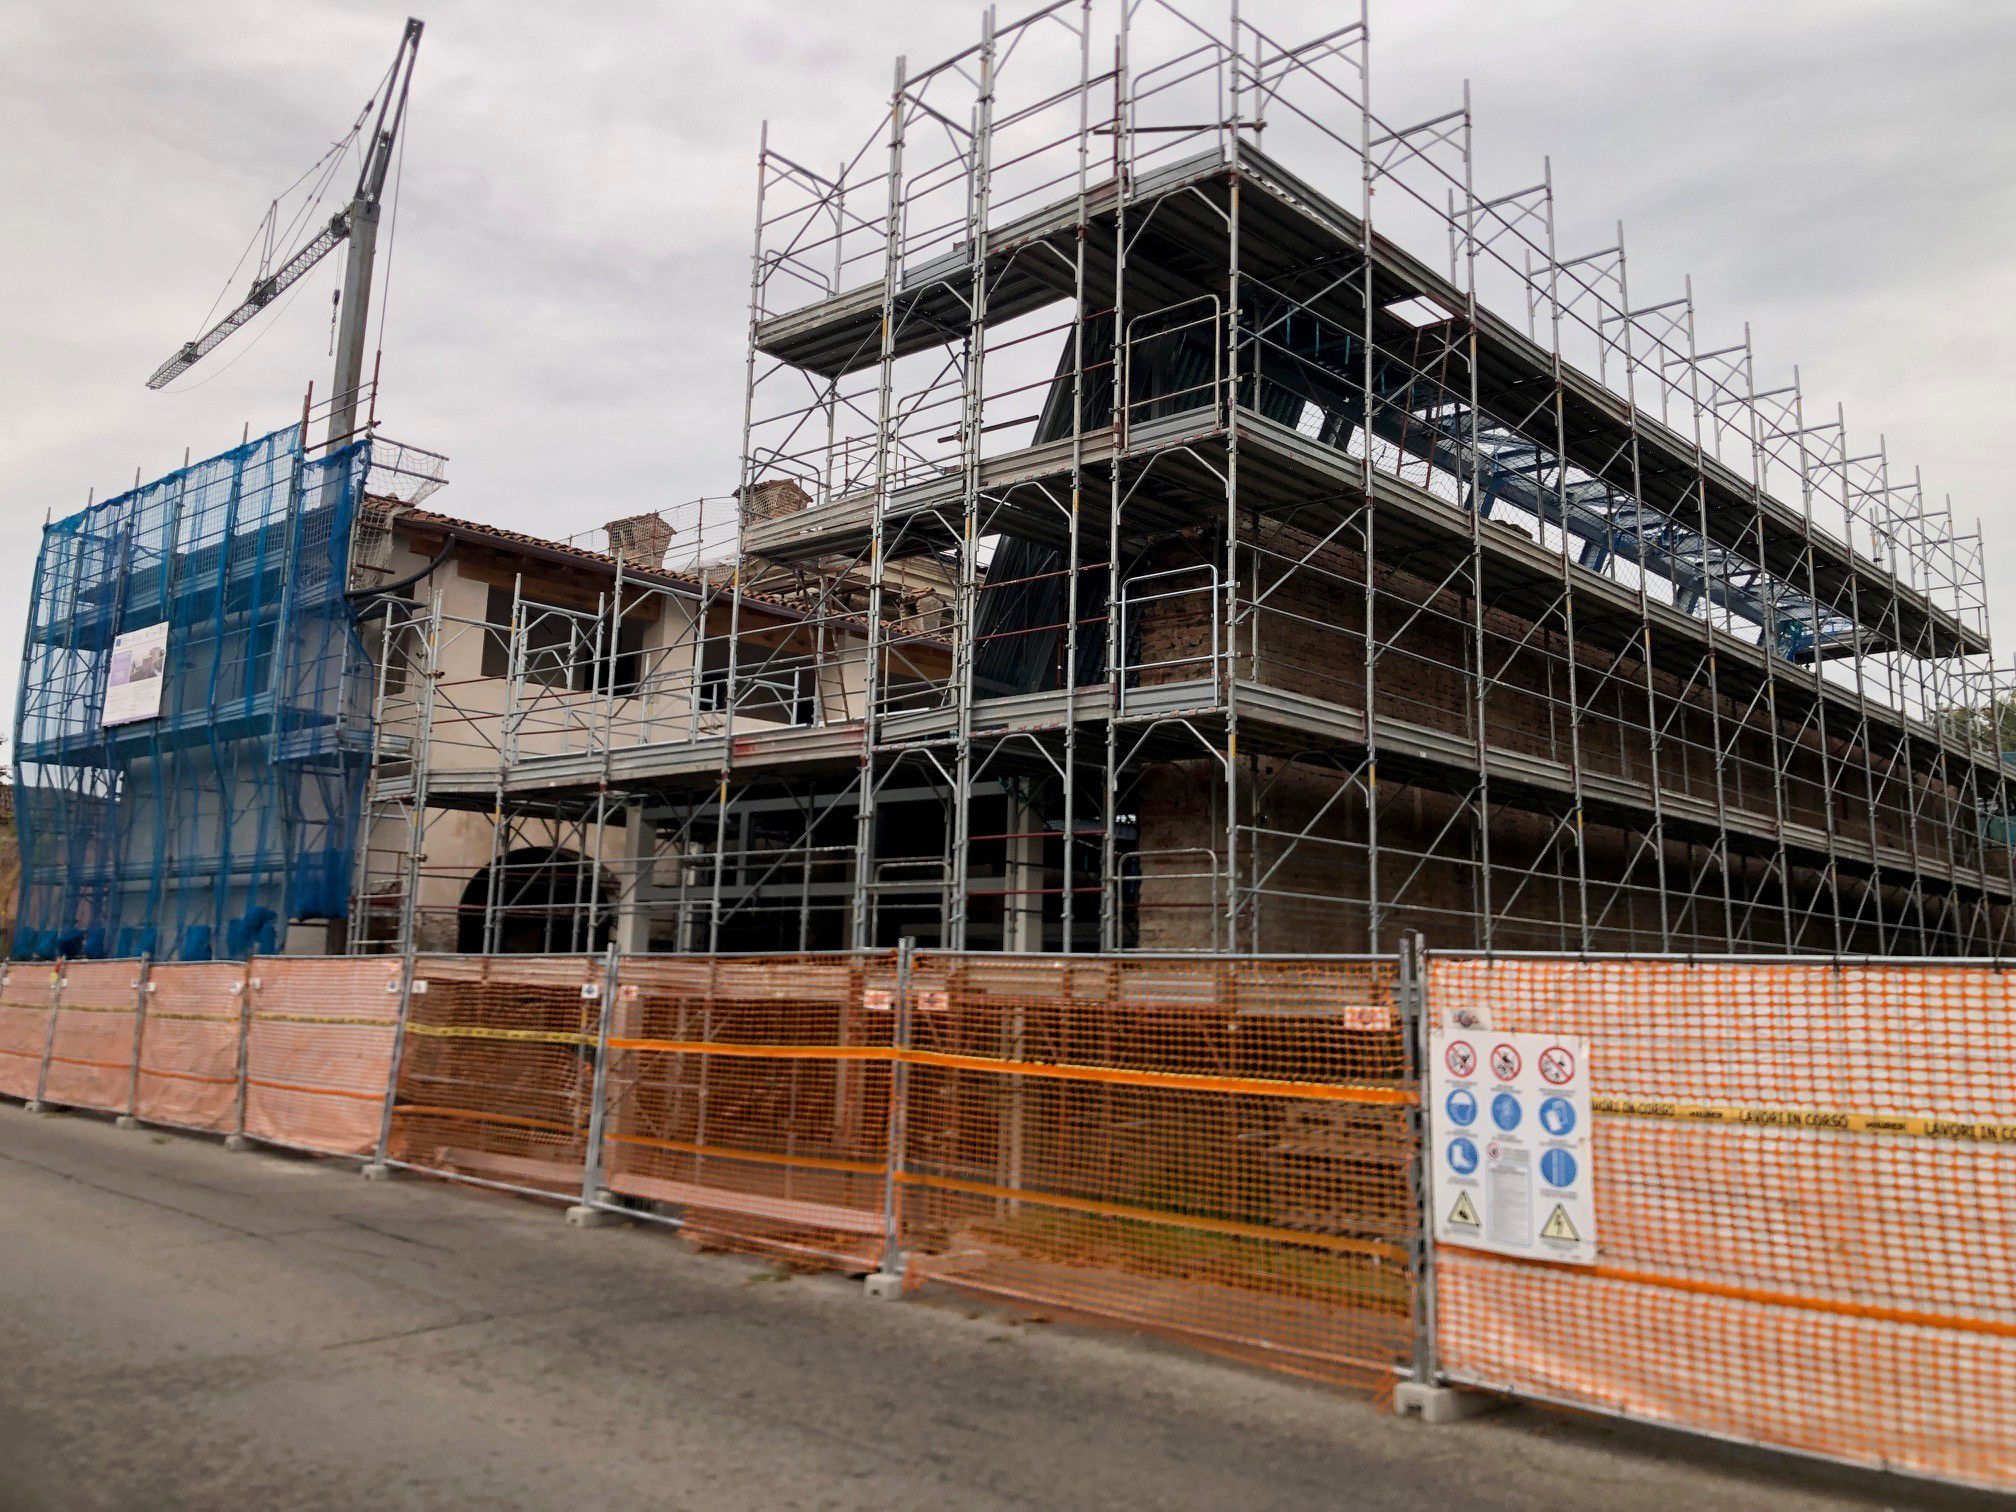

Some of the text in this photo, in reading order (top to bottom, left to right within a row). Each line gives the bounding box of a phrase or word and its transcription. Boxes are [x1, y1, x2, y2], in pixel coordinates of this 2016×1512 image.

[1739, 1109, 1783, 1126] LAVORI
[1786, 1112, 1801, 1127] IN
[1804, 1113, 1849, 1129] CORSO
[1923, 1121, 1975, 1140] LAVORI
[1980, 1125, 1998, 1141] IN
